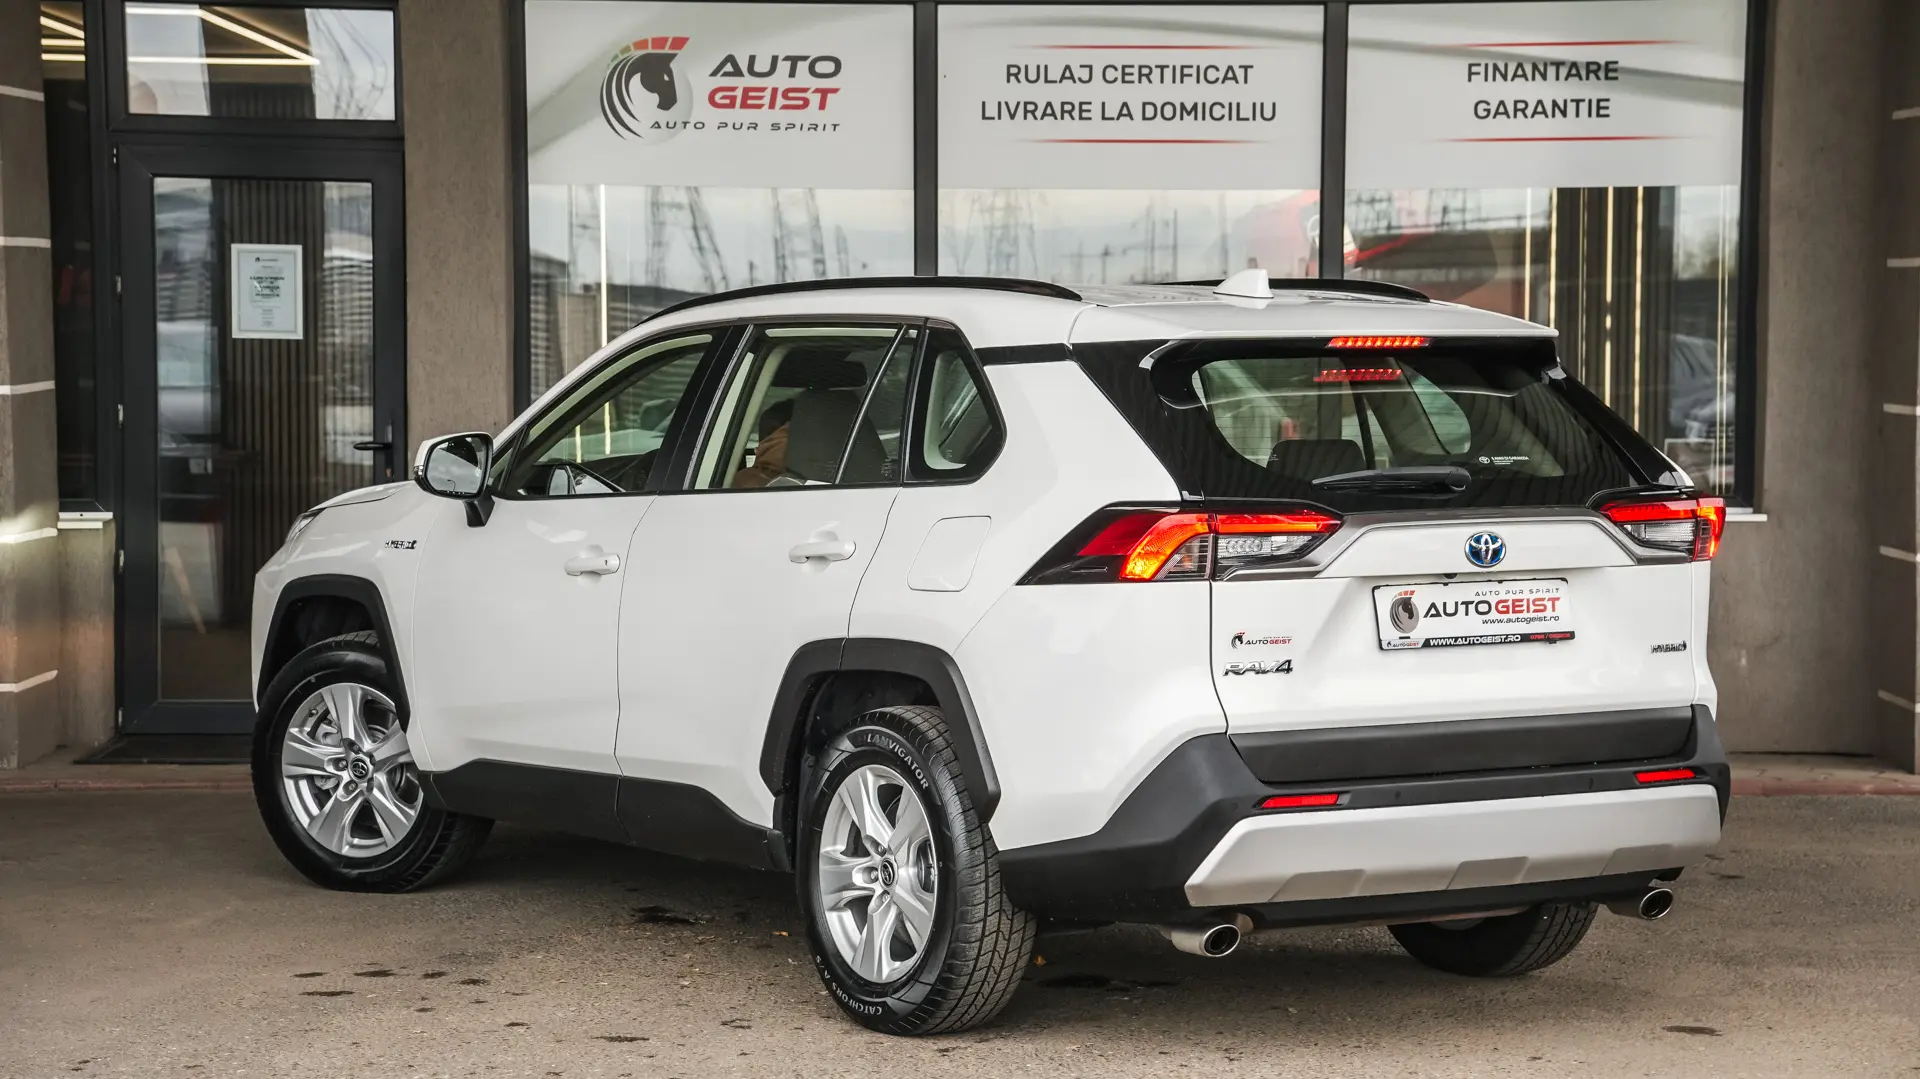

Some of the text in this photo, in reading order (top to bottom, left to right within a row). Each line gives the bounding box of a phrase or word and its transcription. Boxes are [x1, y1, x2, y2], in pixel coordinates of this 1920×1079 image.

[708, 54, 842, 79] AUTO
[1006, 64, 1254, 84] RULAJ CERTIFICAT
[1467, 60, 1619, 82] FINANTARE
[707, 86, 841, 111] GEIST
[1473, 98, 1611, 120] GARANTIE
[981, 101, 1277, 122] LIVRARE LA DOMICILIU
[650, 120, 841, 132] AUTO PUR SPIRIT
[1528, 587, 1560, 595] SPIRIT
[1422, 596, 1561, 619] AUTOGEIST
[1482, 615, 1560, 625] www.autogeist.ro
[1430, 633, 1522, 647] WWW.AUTOGEIST.RO
[1222, 659, 1293, 677] RAV4
[867, 733, 929, 790] LANVIGATOR
[832, 982, 883, 1016] CATCHFORS
